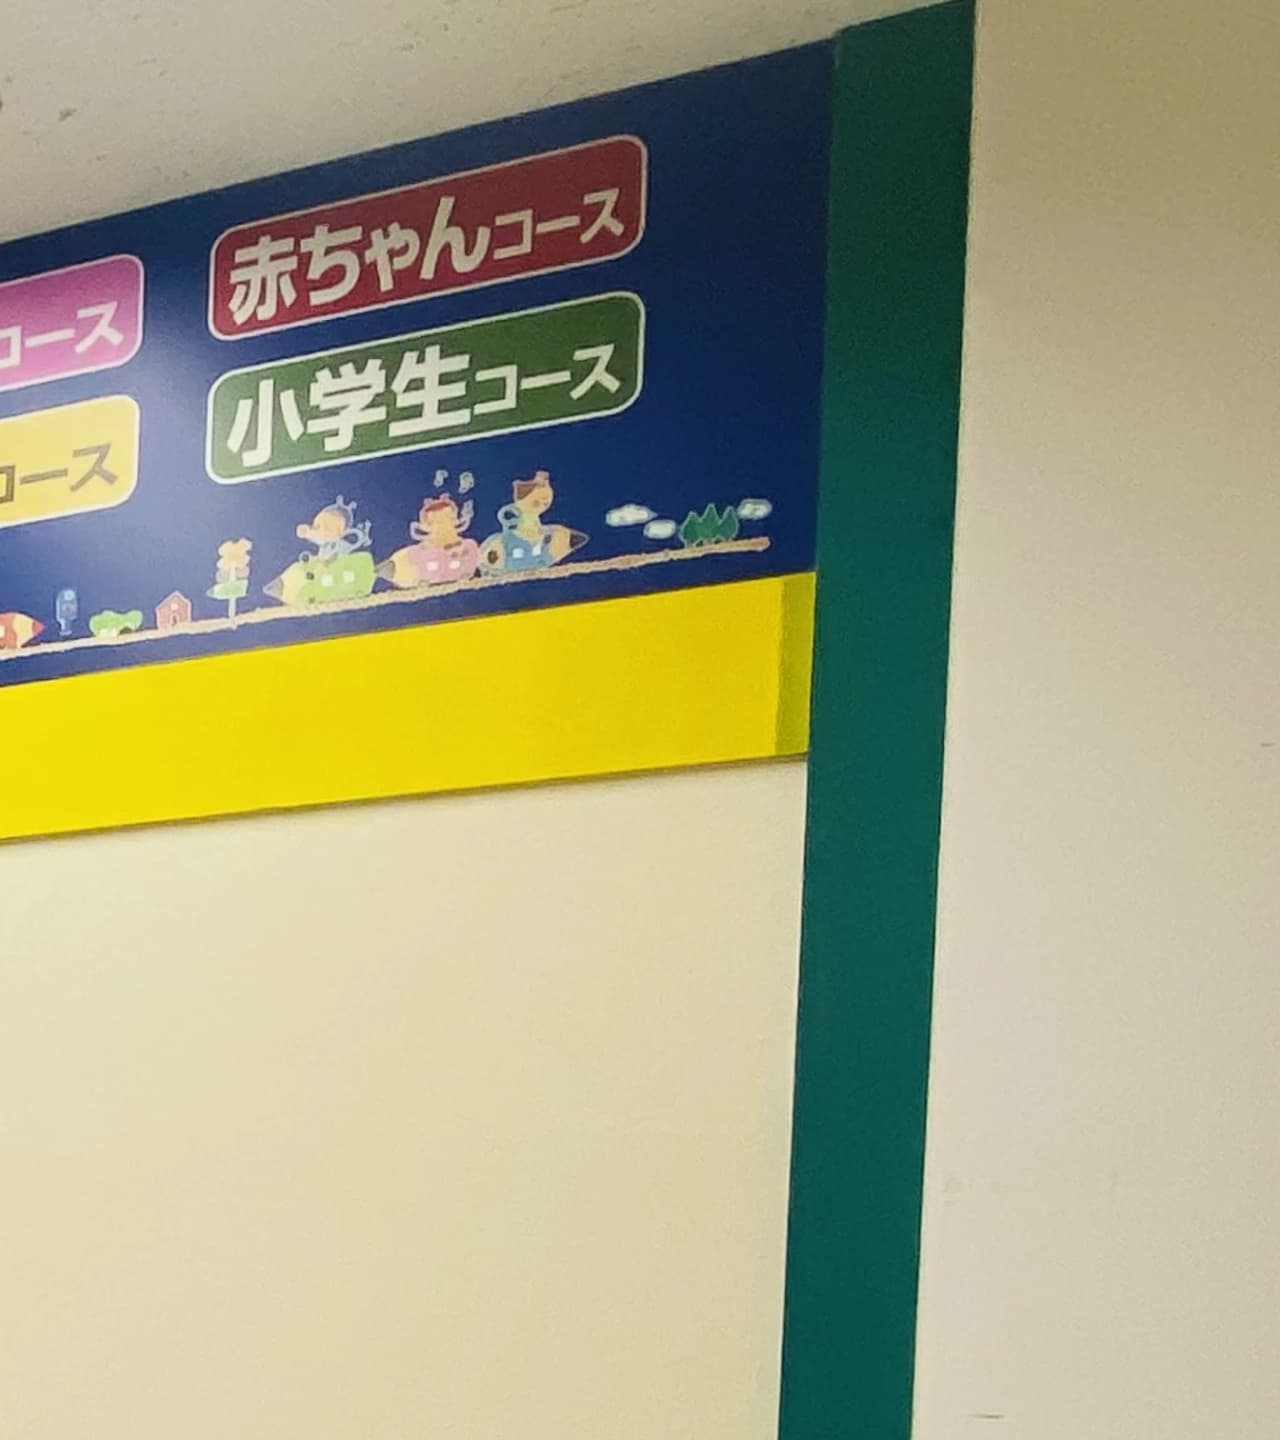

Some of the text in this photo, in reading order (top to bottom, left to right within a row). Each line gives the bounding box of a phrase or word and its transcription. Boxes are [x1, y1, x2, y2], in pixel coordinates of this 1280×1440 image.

[228, 188, 625, 326] 赤ちゃんコース
[226, 344, 622, 467] 小学生コース
